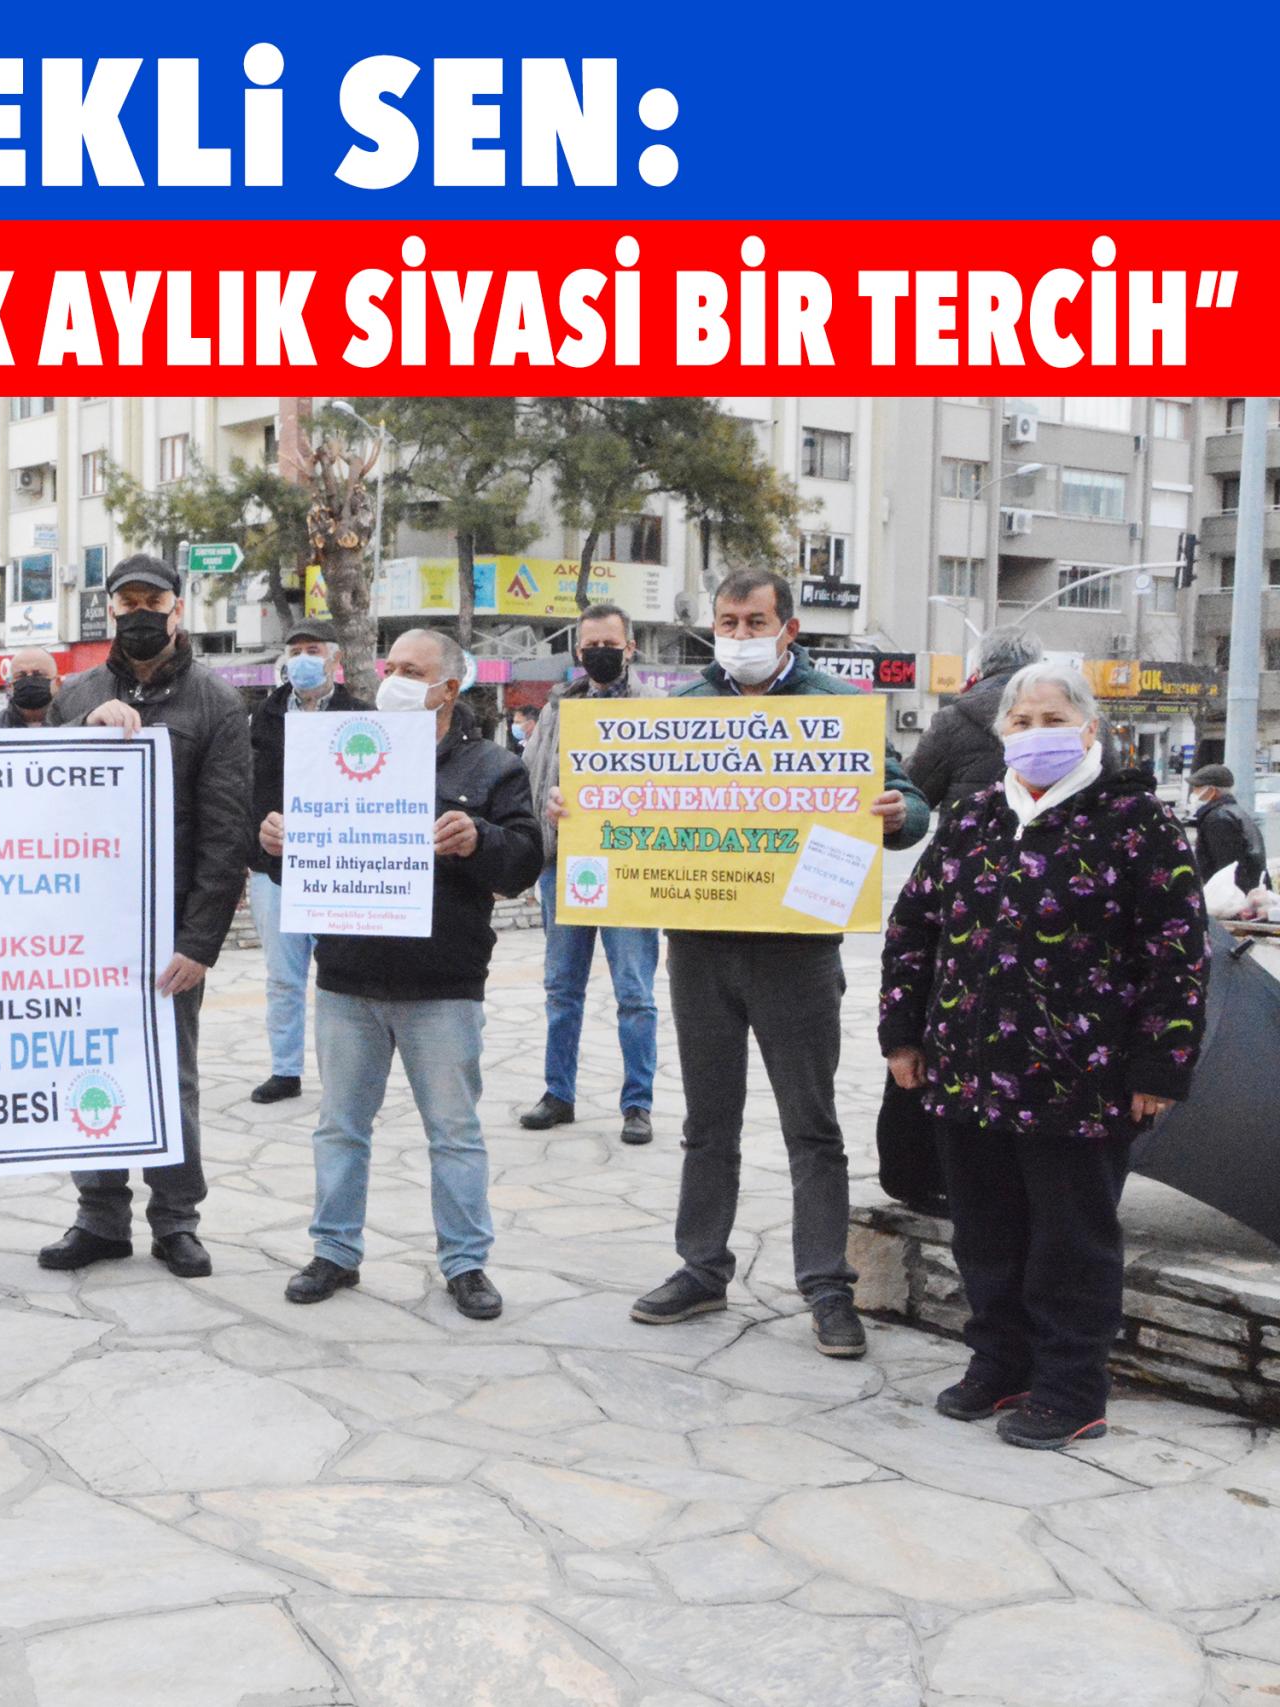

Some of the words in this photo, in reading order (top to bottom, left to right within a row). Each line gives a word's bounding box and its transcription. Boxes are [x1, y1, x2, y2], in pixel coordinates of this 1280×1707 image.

[814, 657, 875, 682] GEZER
[879, 660, 915, 683] GSM
[598, 713, 789, 741] YOLSUZLUĞA
[799, 718, 841, 739] VE
[570, 747, 763, 773] YOKSULLUĞA
[773, 752, 871, 773] HAYIR
[25, 761, 124, 788] ÜCRET
[290, 796, 350, 818] Asgari
[356, 797, 429, 815] ücretten
[578, 780, 860, 816] GEÇİNEMİYORUZ
[287, 827, 333, 848] vergi
[338, 827, 430, 845] alınmasın.
[600, 821, 799, 853] İSYANDAYIZ
[288, 855, 331, 869] Temel
[336, 856, 429, 873] ihtiyaçlardan
[615, 865, 639, 880] TÜM
[643, 866, 707, 882] EMEKLİLER
[711, 867, 775, 884] SENDİKASI
[303, 879, 328, 893] kdv
[332, 880, 411, 895] kaldırılsın!
[11, 1027, 119, 1070] DEVLET
